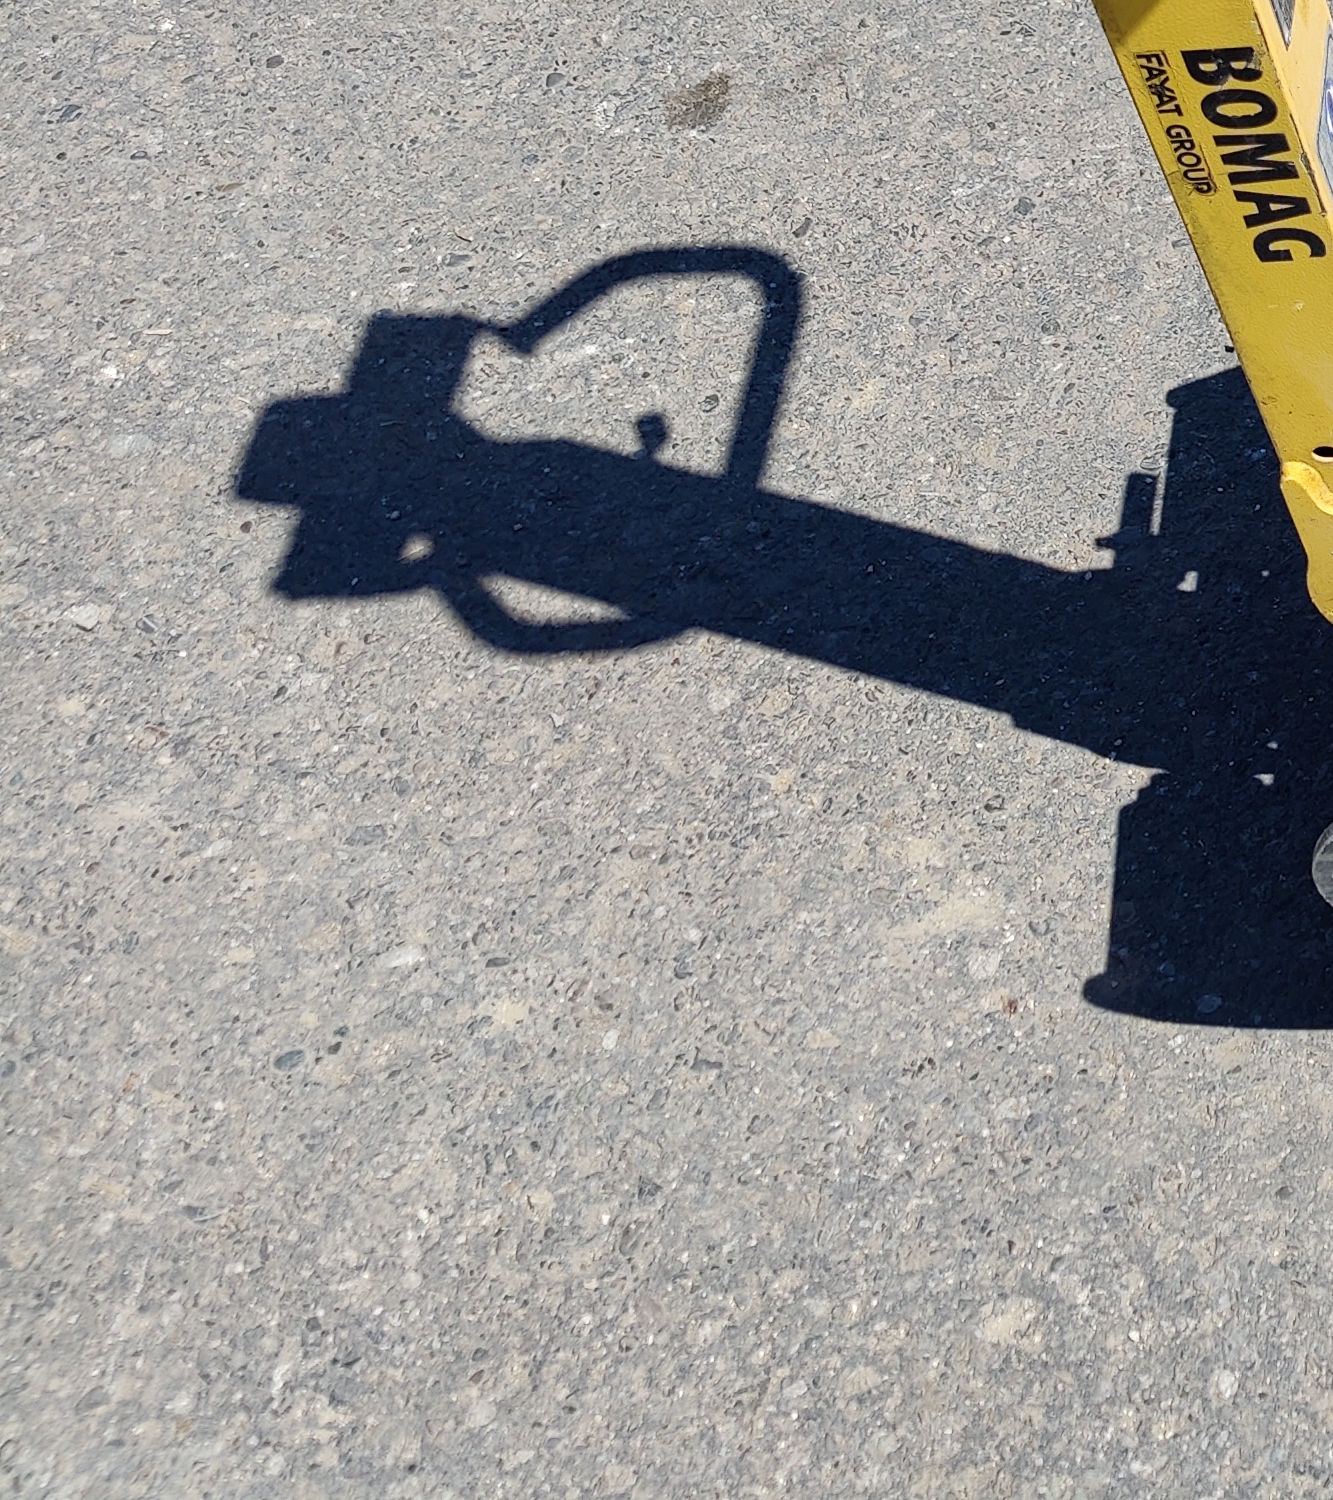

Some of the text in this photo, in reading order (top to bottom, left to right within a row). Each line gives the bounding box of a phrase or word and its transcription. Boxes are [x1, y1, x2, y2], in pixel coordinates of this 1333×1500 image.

[1135, 53, 1217, 196] FAYAT GROUP
[1181, 46, 1327, 263] BOMAG
